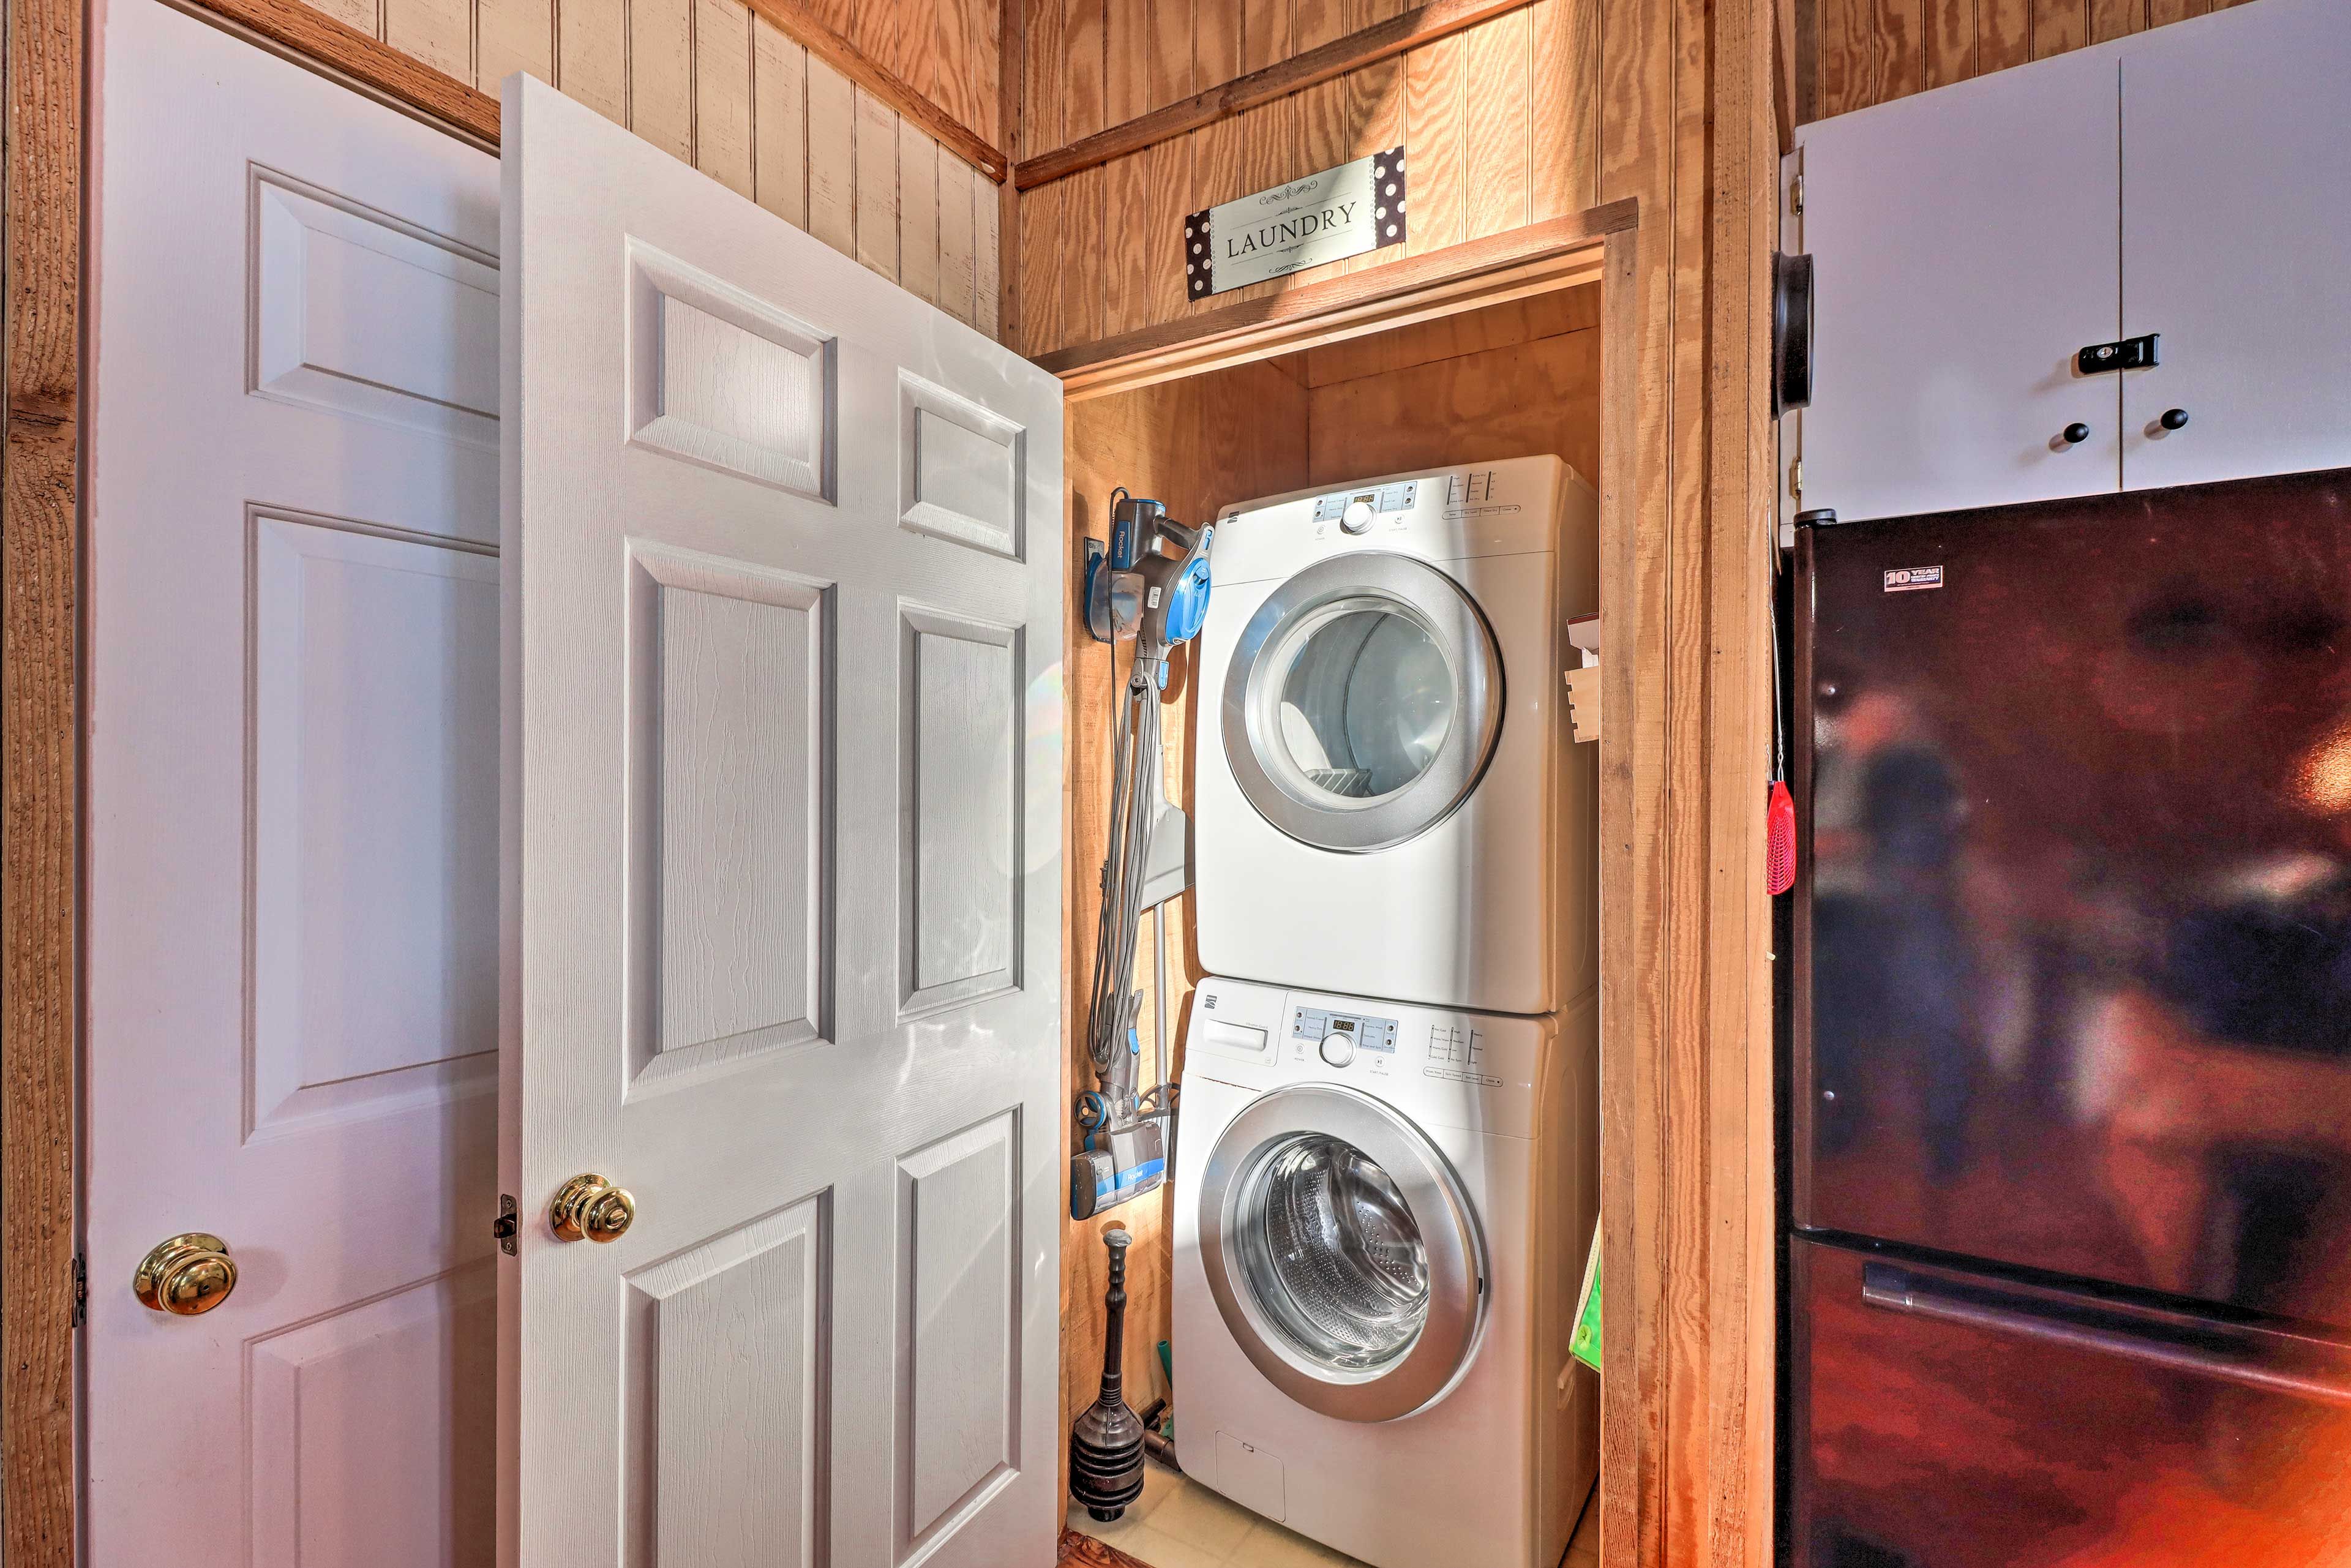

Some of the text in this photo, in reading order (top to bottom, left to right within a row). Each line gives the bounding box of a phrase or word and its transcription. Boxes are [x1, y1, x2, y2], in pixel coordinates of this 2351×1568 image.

[1227, 201, 1357, 258] LAUNDRY
[1117, 531, 1125, 558] Rocket
[1886, 571, 1910, 584] 10
